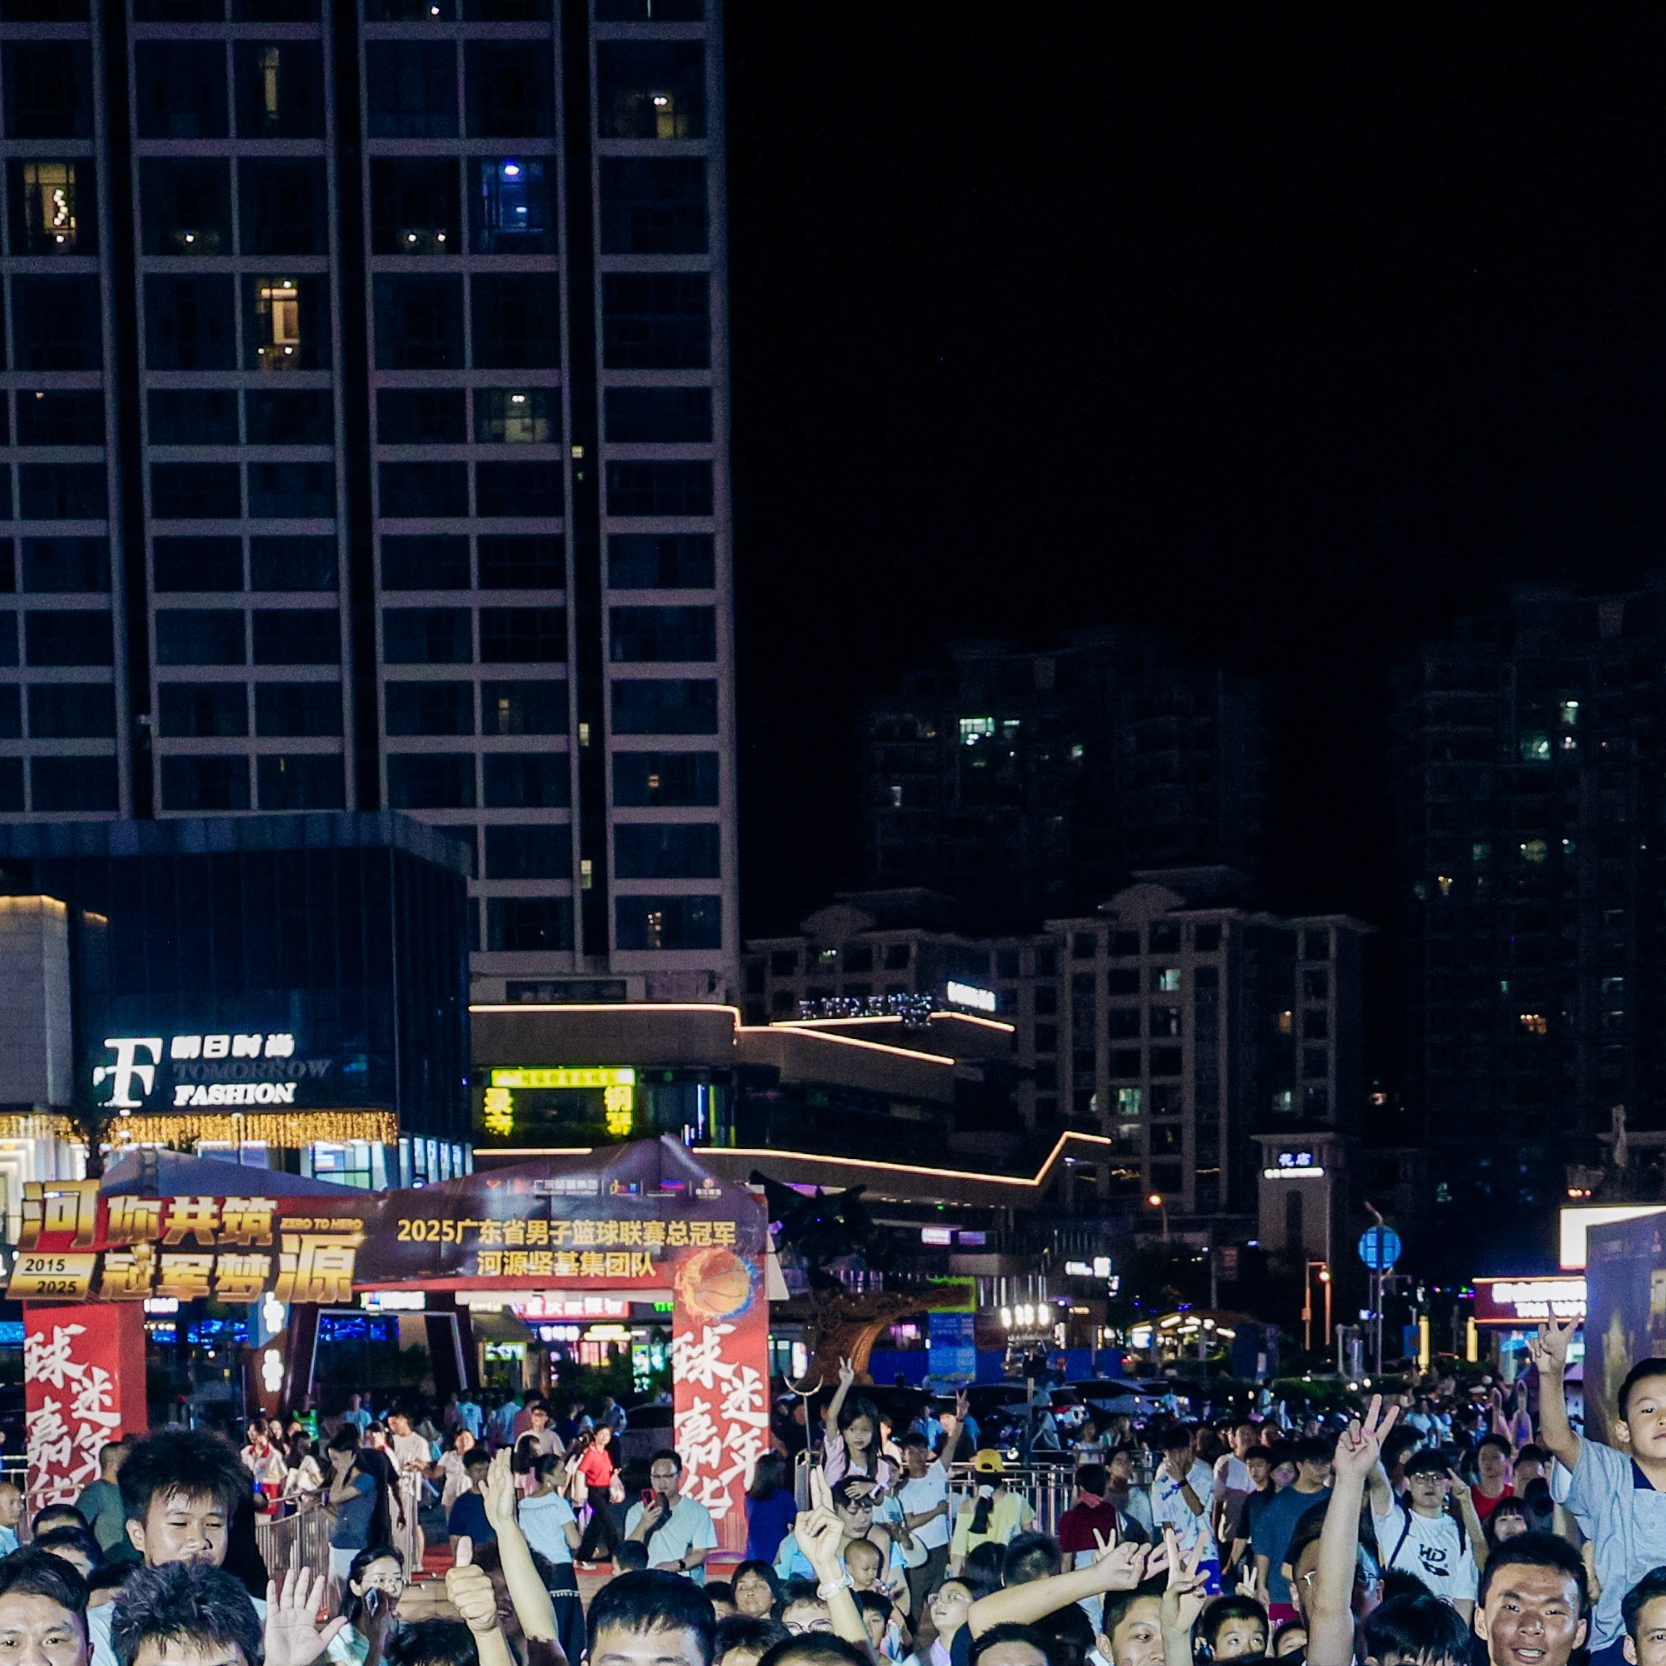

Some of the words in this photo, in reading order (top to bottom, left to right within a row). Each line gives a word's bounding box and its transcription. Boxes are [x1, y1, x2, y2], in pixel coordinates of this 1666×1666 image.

[174, 1059, 333, 1080] TOMORROW
[173, 1082, 298, 1106] FASHION
[18, 1179, 277, 1250] 河你共筑
[396, 1218, 736, 1247] 2025广东省男子篮球联赛总冠军
[24, 1258, 66, 1272] 2015
[476, 1250, 657, 1279] 河源坚基集团队
[36, 1280, 78, 1294] 2025
